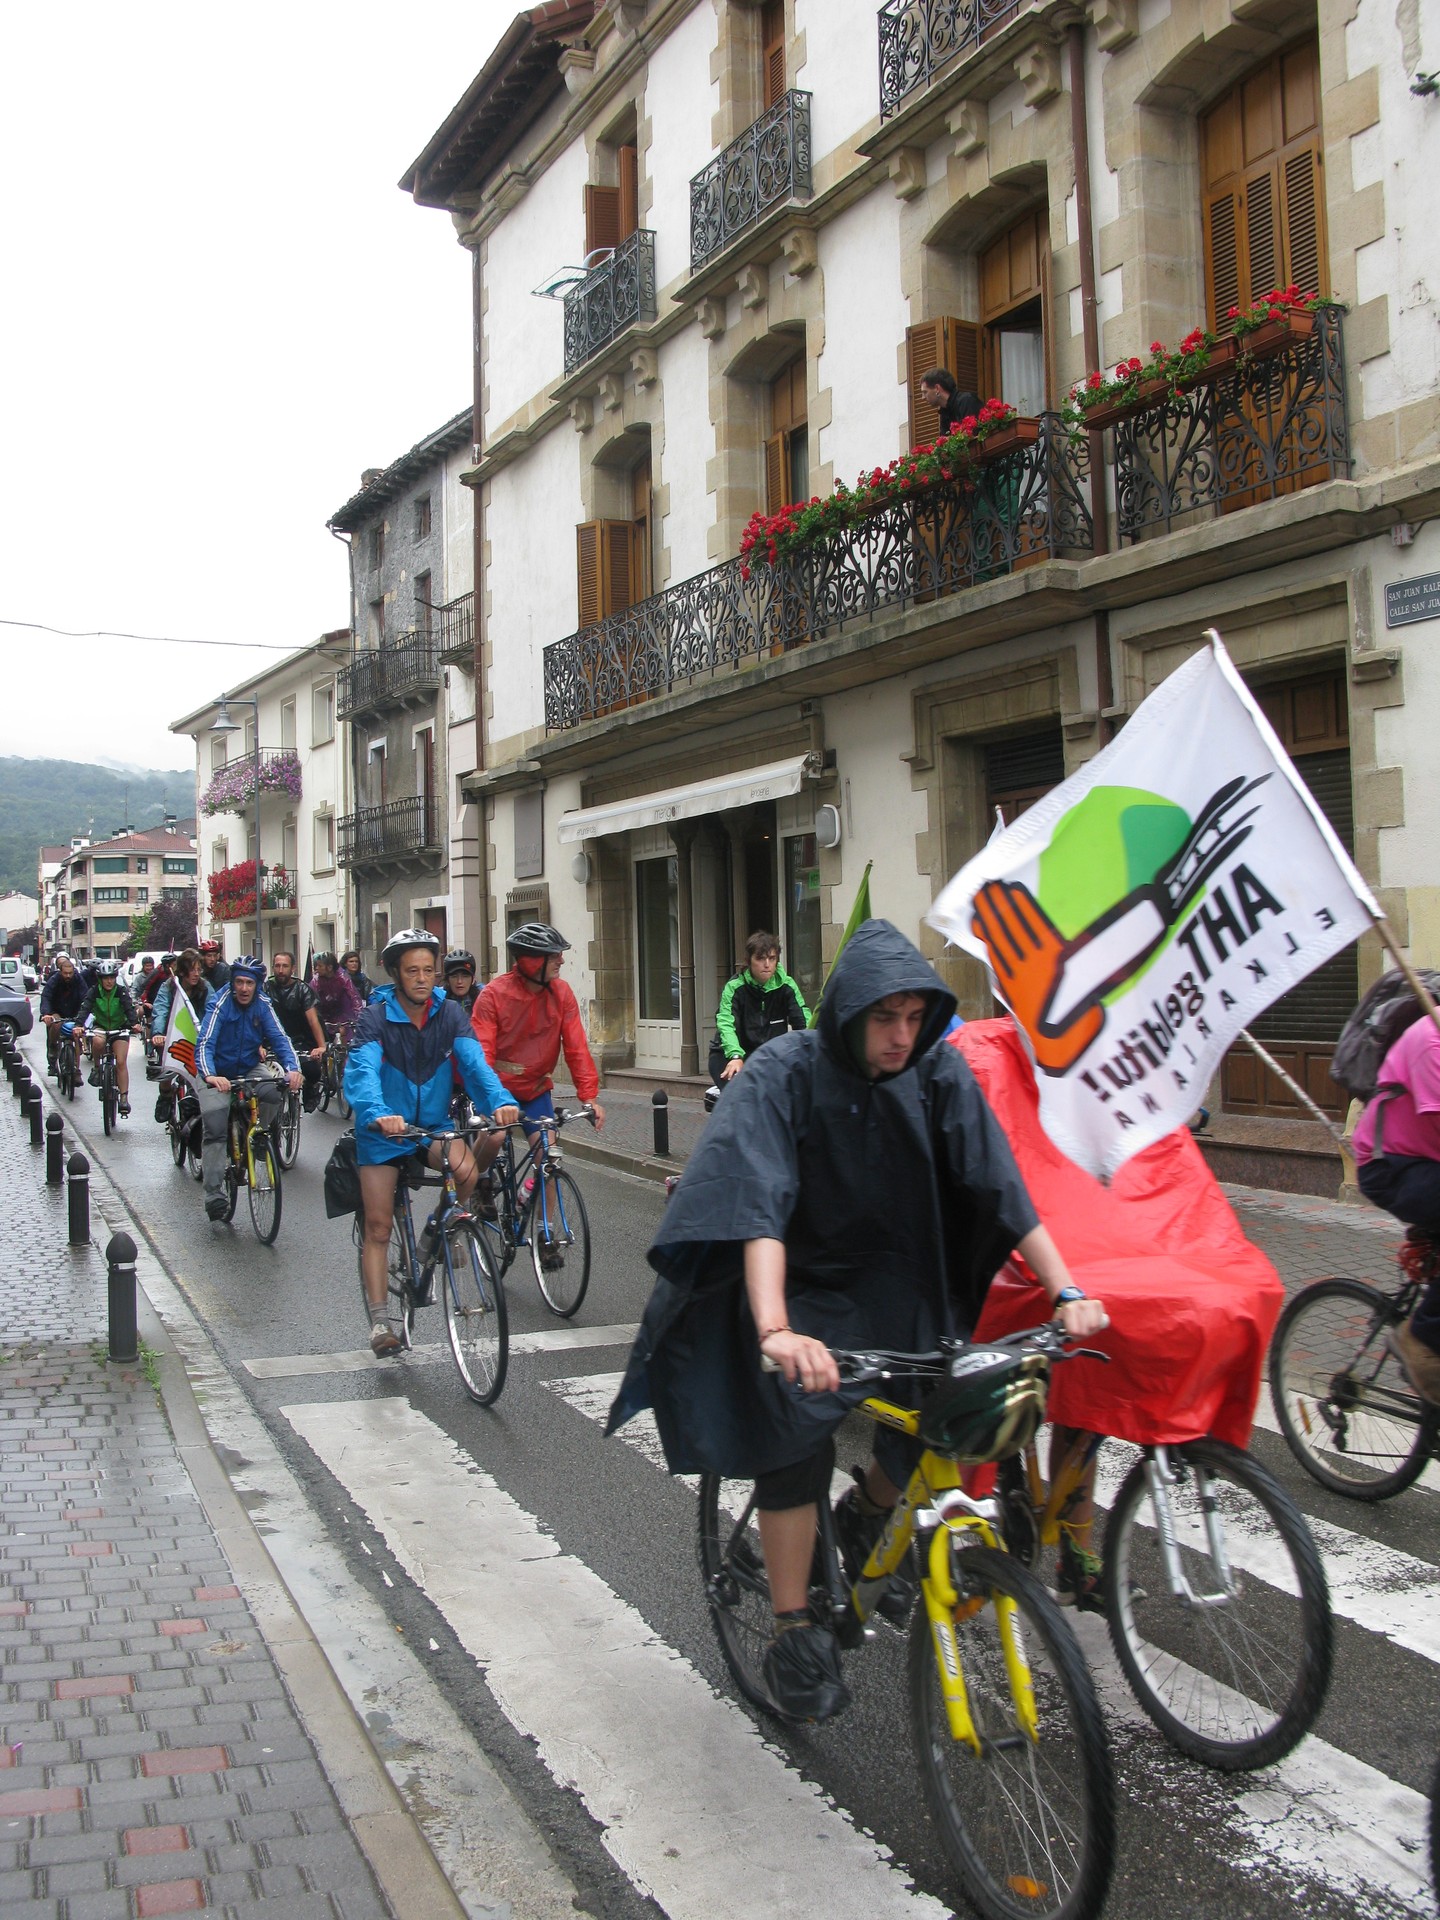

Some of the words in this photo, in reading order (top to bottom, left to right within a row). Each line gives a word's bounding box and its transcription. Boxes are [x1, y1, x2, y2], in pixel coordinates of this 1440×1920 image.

[1388, 590, 1401, 602] SAN
[1403, 585, 1420, 598] JUAN
[1389, 604, 1410, 617] CALLE
[1411, 600, 1425, 612] SAN
